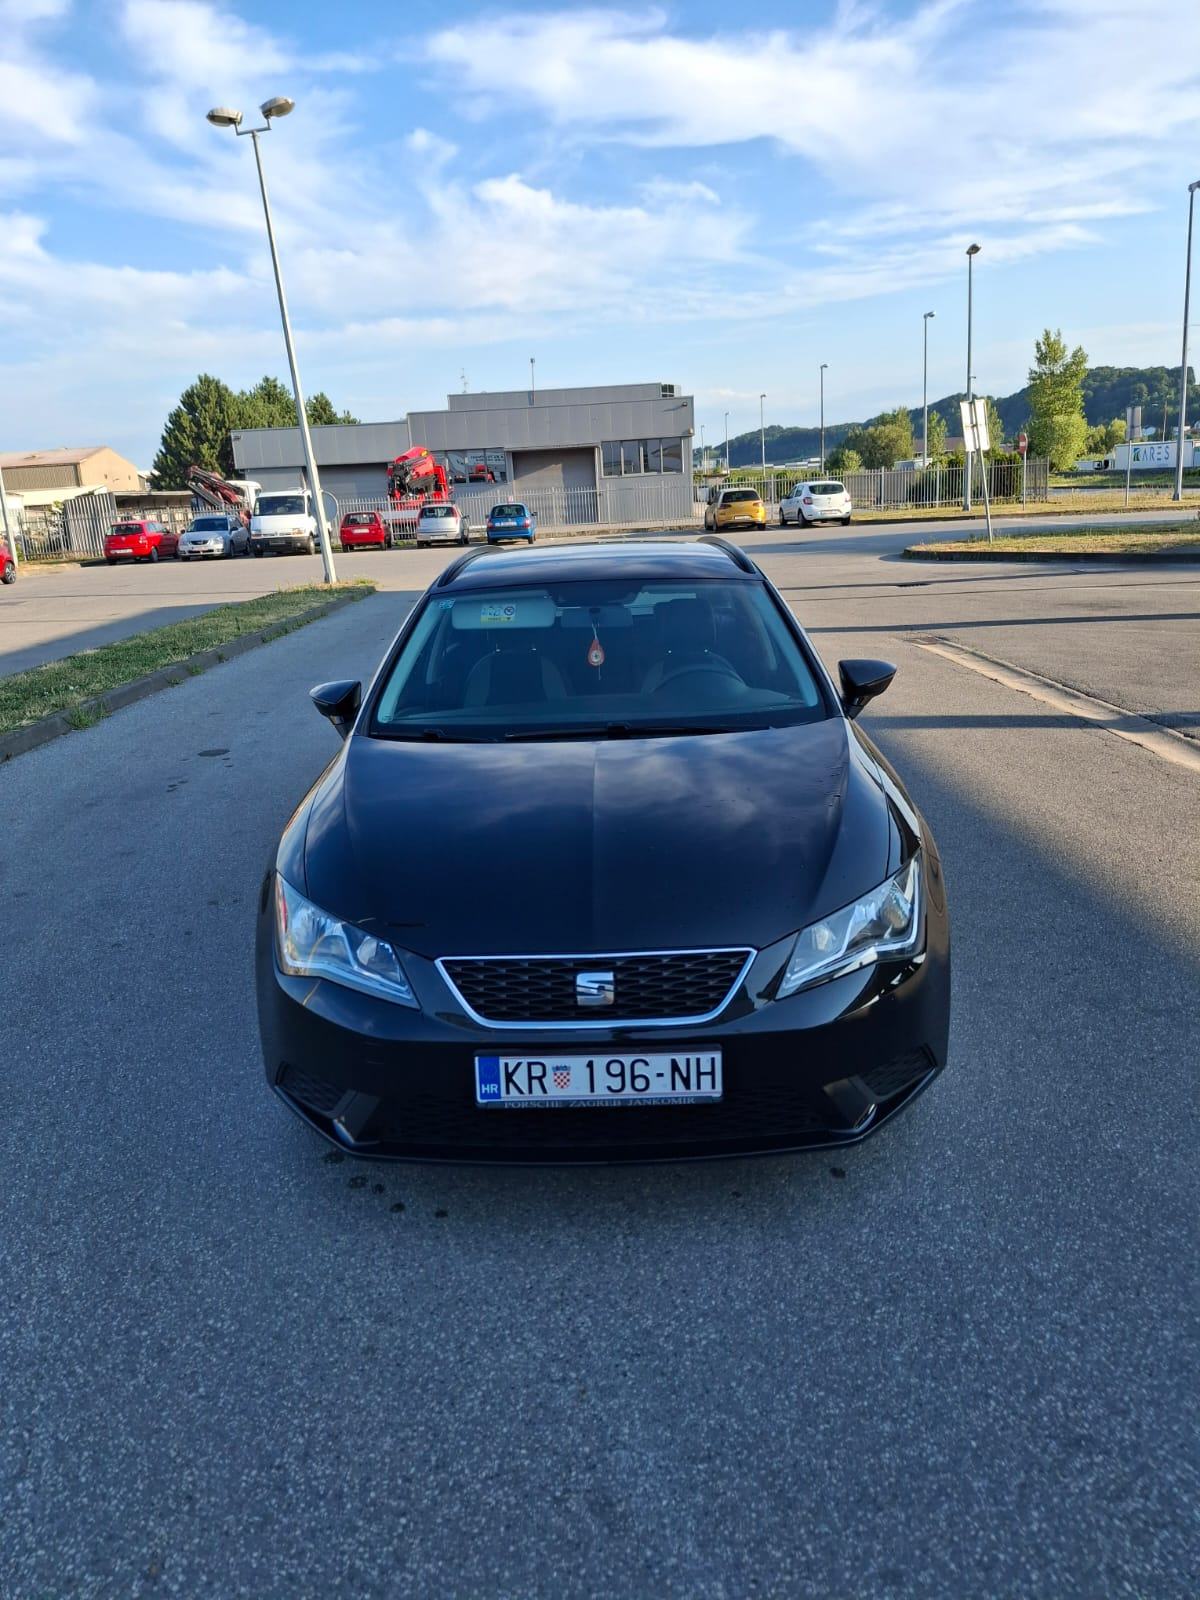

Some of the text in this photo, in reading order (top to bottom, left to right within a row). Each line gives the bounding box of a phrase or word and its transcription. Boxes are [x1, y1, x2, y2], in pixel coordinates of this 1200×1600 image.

[504, 1056, 716, 1095] KR 196-NH
[481, 1083, 498, 1094] HR
[504, 1097, 696, 1109] PORSCHE ZAGREB JANKOMIR
